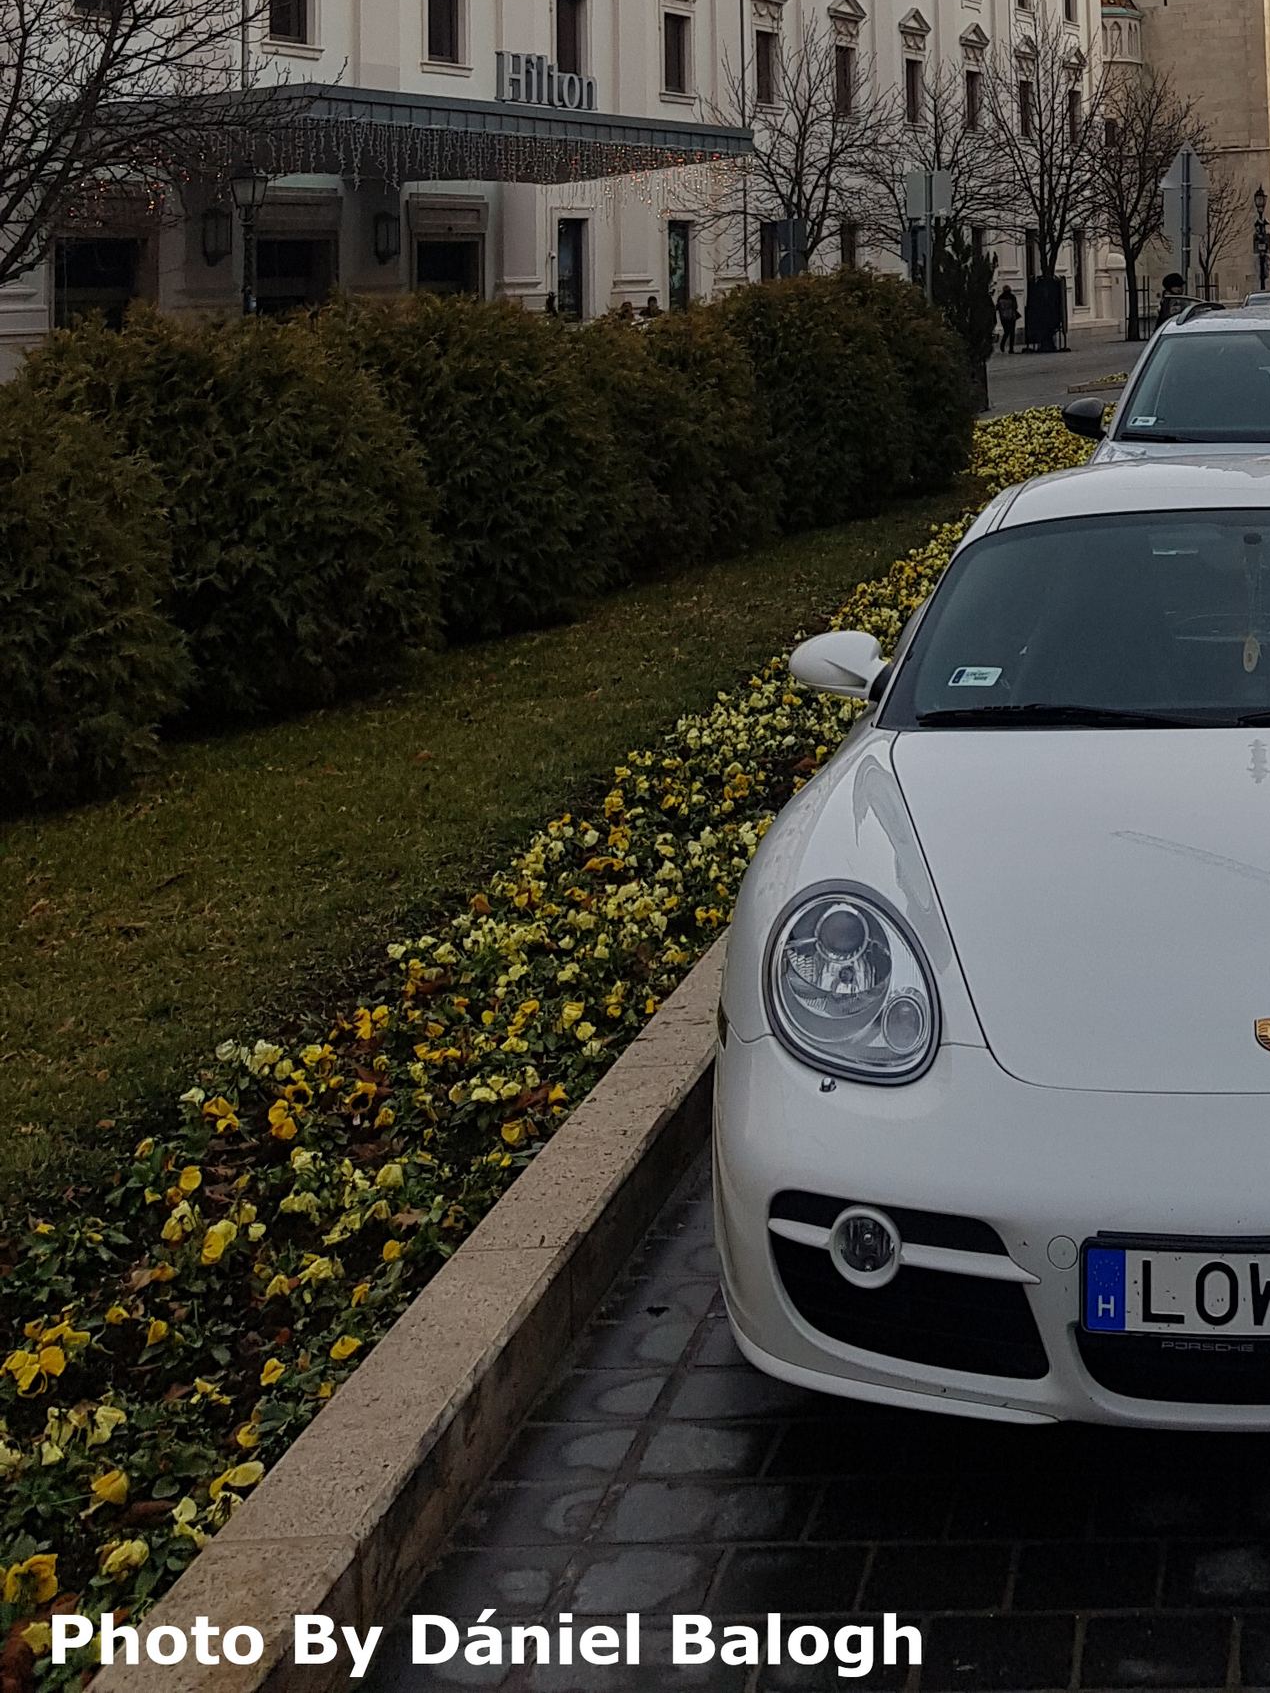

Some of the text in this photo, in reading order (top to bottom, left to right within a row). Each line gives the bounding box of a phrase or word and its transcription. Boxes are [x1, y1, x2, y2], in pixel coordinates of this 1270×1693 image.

[495, 50, 598, 110] Hilton
[1097, 1295, 1115, 1319] H
[1161, 1341, 1255, 1352] PORSCHE
